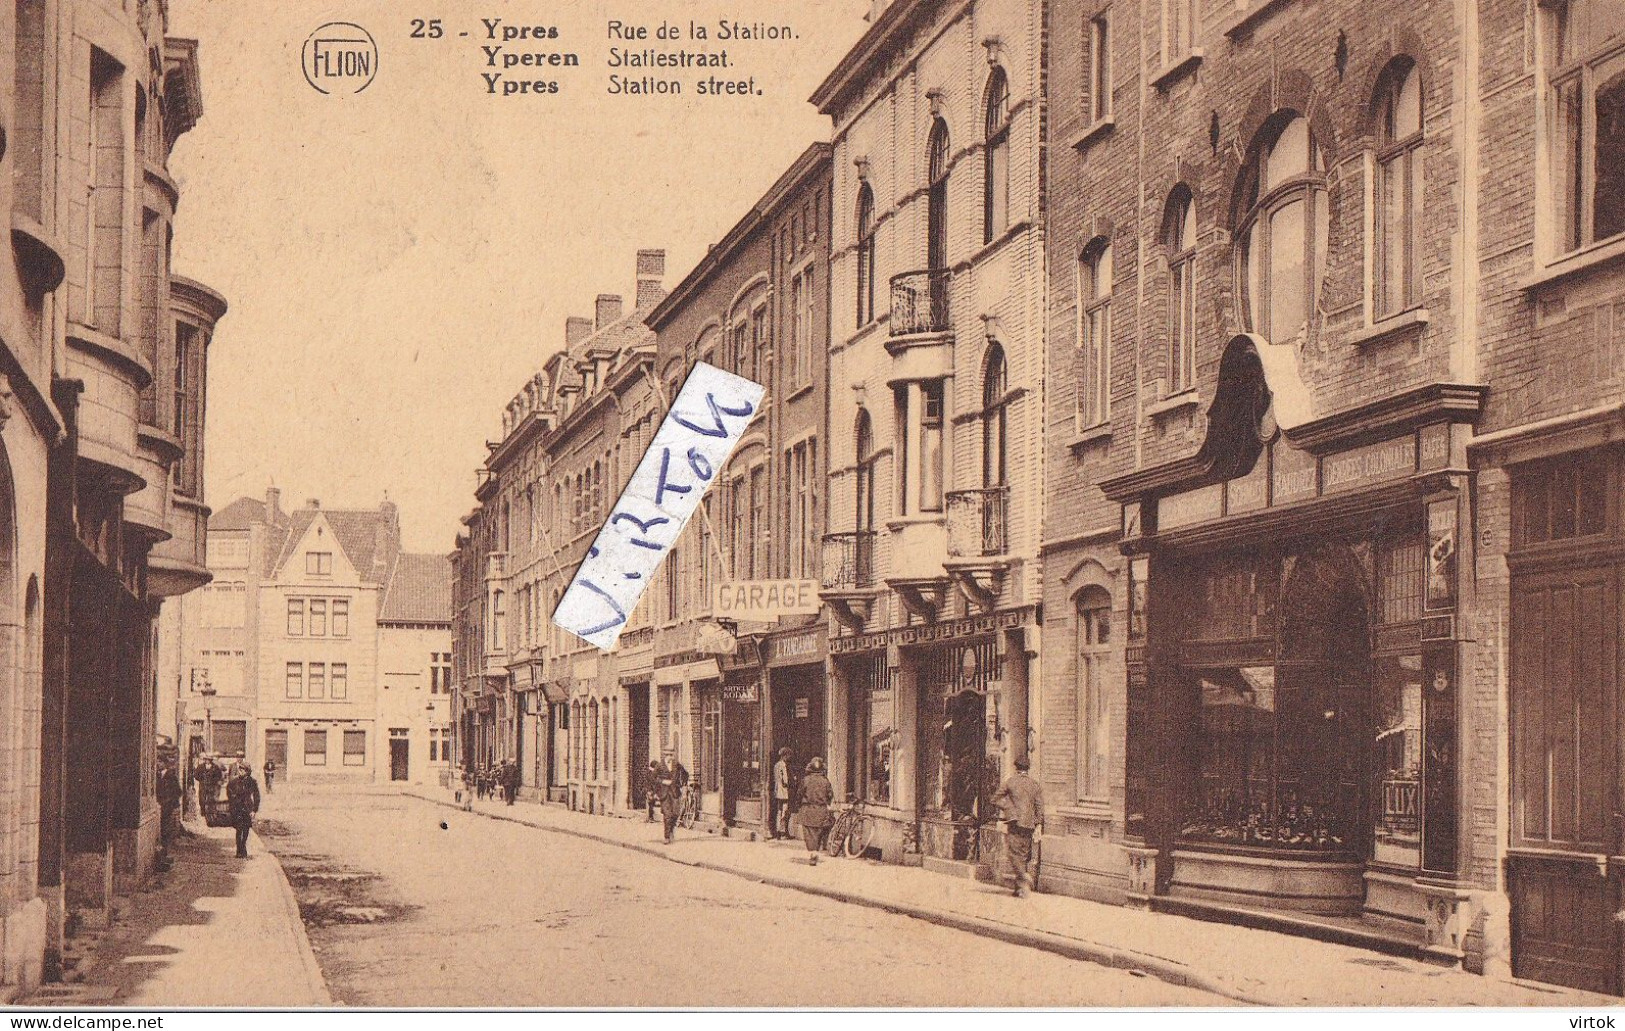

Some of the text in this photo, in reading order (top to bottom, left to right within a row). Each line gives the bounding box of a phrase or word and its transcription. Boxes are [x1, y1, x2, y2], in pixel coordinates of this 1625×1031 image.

[719, 582, 812, 611] GARAGE
[723, 691, 754, 700] KODAK
[1385, 786, 1416, 815] LUX
